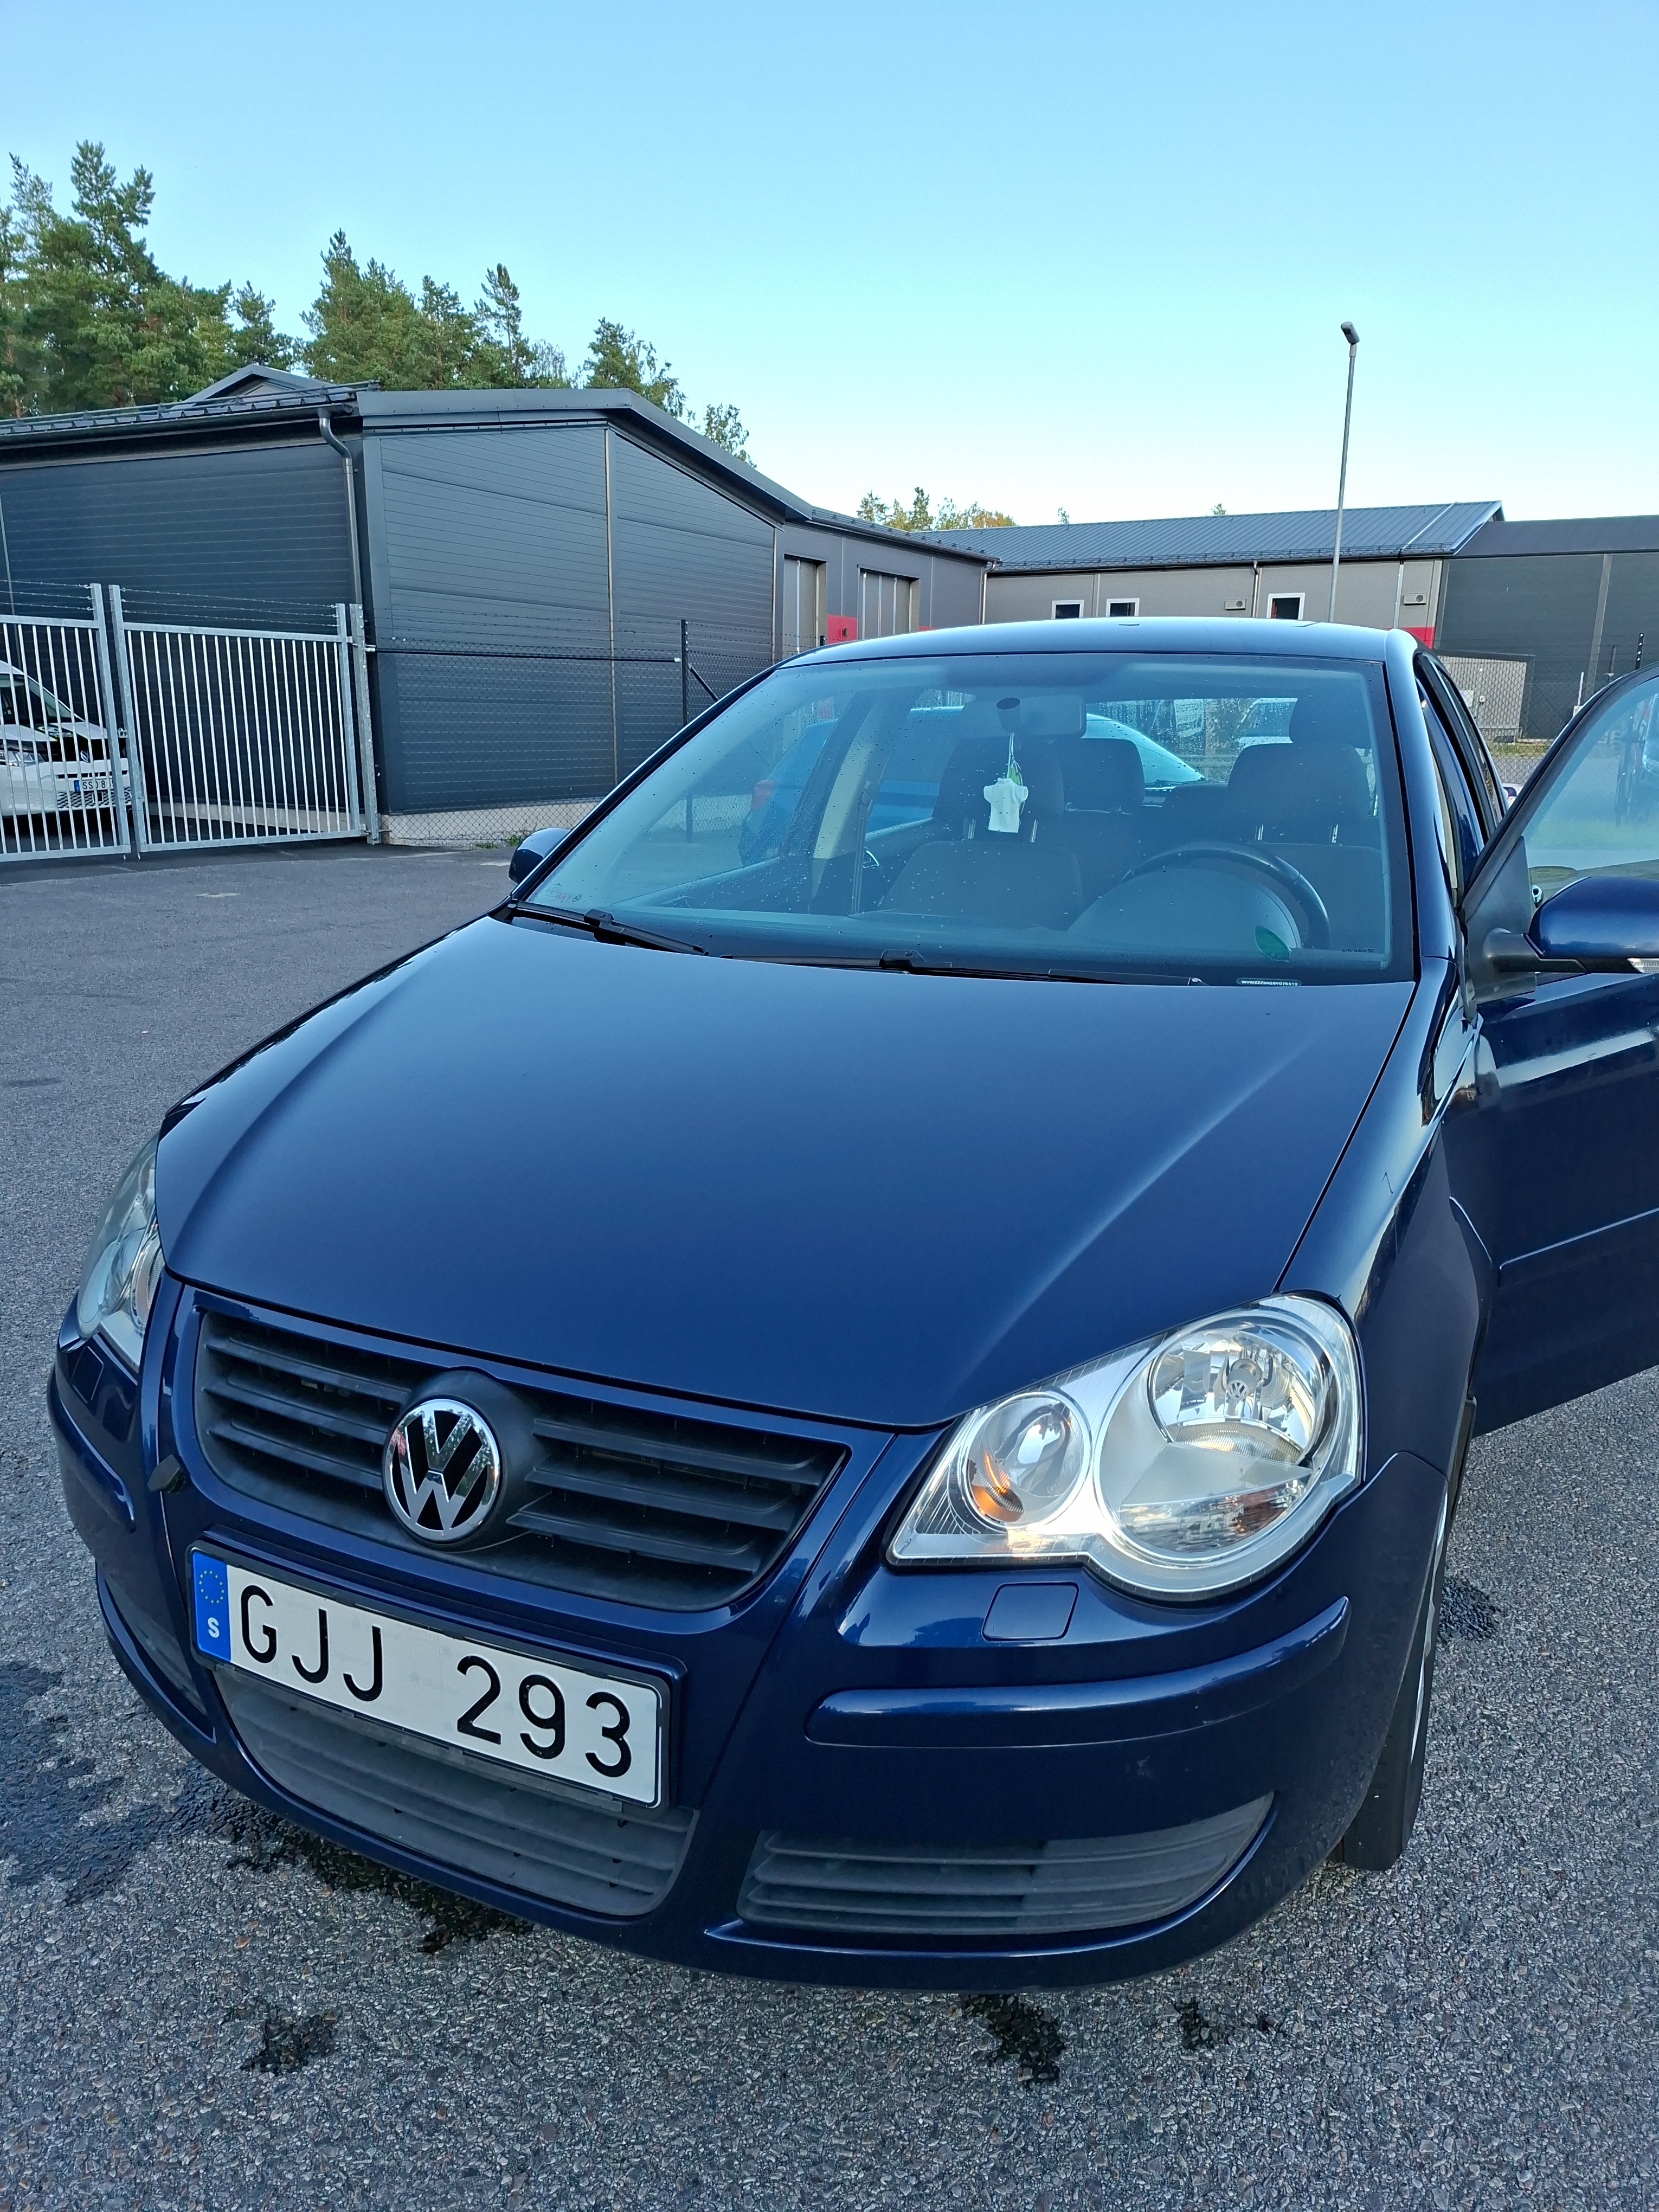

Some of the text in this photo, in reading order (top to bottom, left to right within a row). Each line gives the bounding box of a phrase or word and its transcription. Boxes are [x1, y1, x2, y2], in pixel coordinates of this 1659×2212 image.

[388, 1401, 497, 1538] VW
[208, 1617, 220, 1638] S
[241, 1585, 632, 1778] GJJ 293
